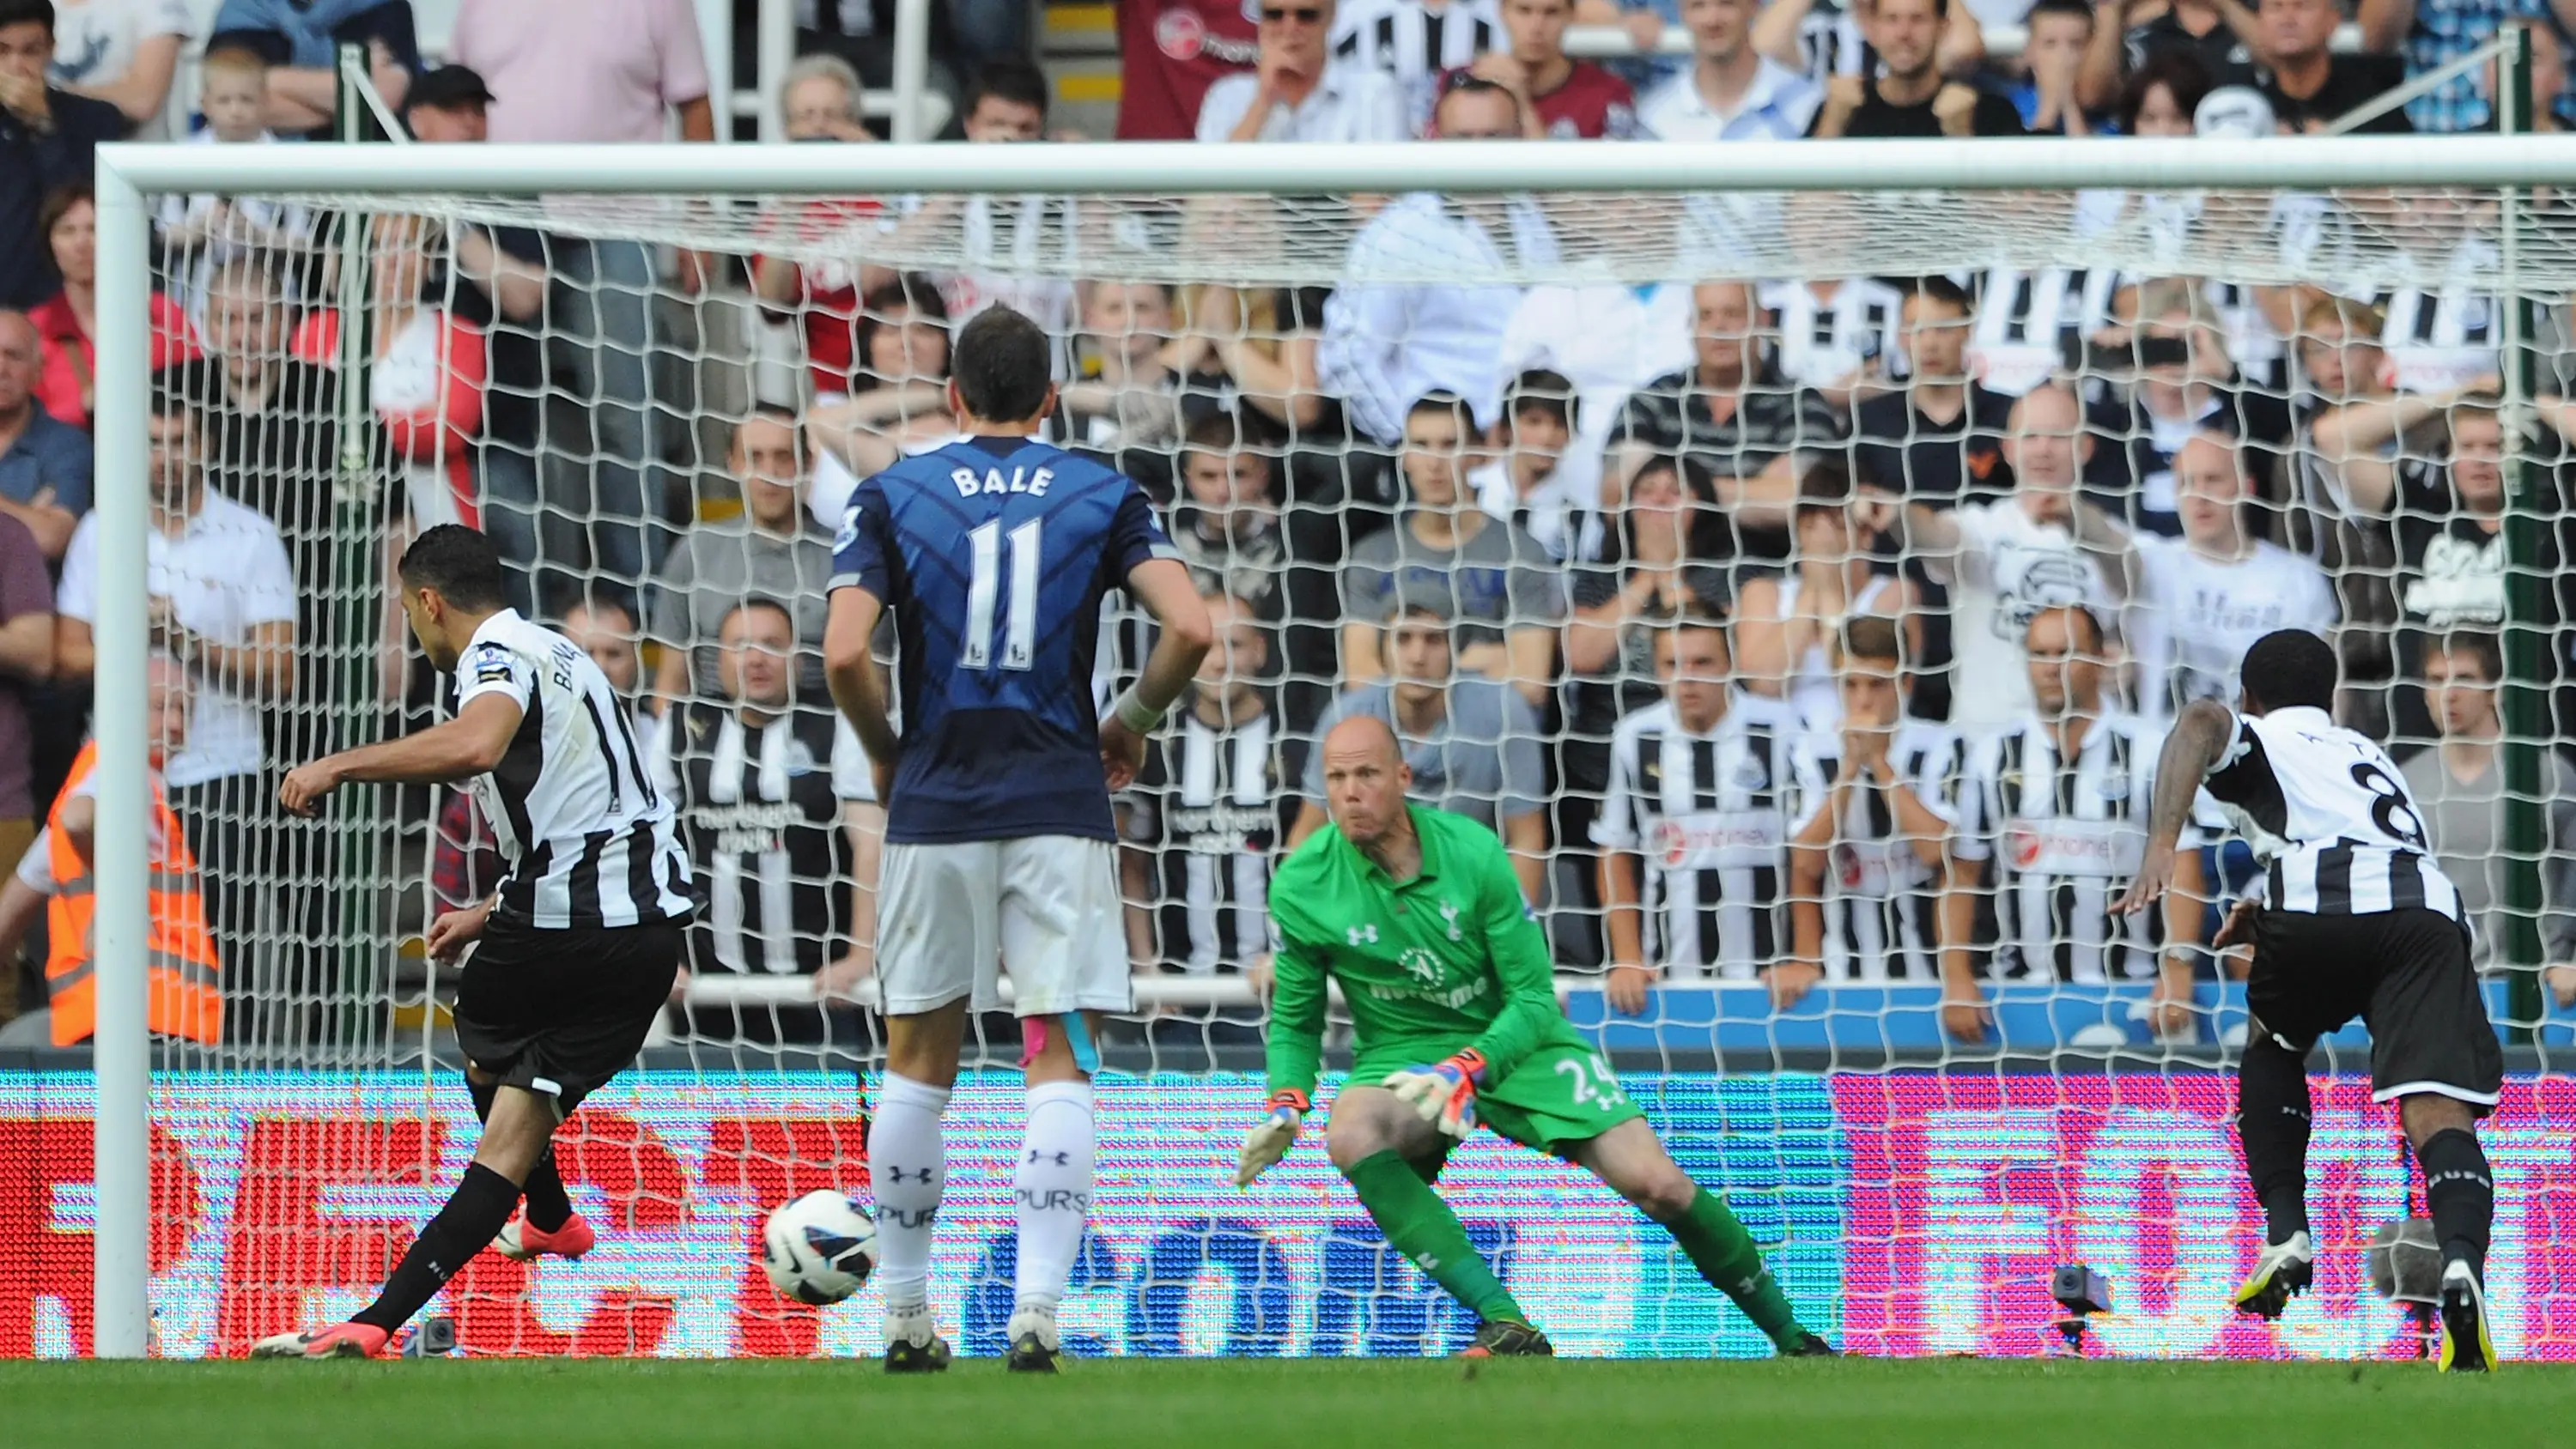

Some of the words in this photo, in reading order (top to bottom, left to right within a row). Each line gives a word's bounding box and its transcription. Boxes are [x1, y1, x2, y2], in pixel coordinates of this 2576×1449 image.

[949, 465, 1055, 498] BALE
[957, 517, 1042, 671] 11
[2350, 762, 2428, 850] 8
[1553, 1053, 1623, 1106] 24
